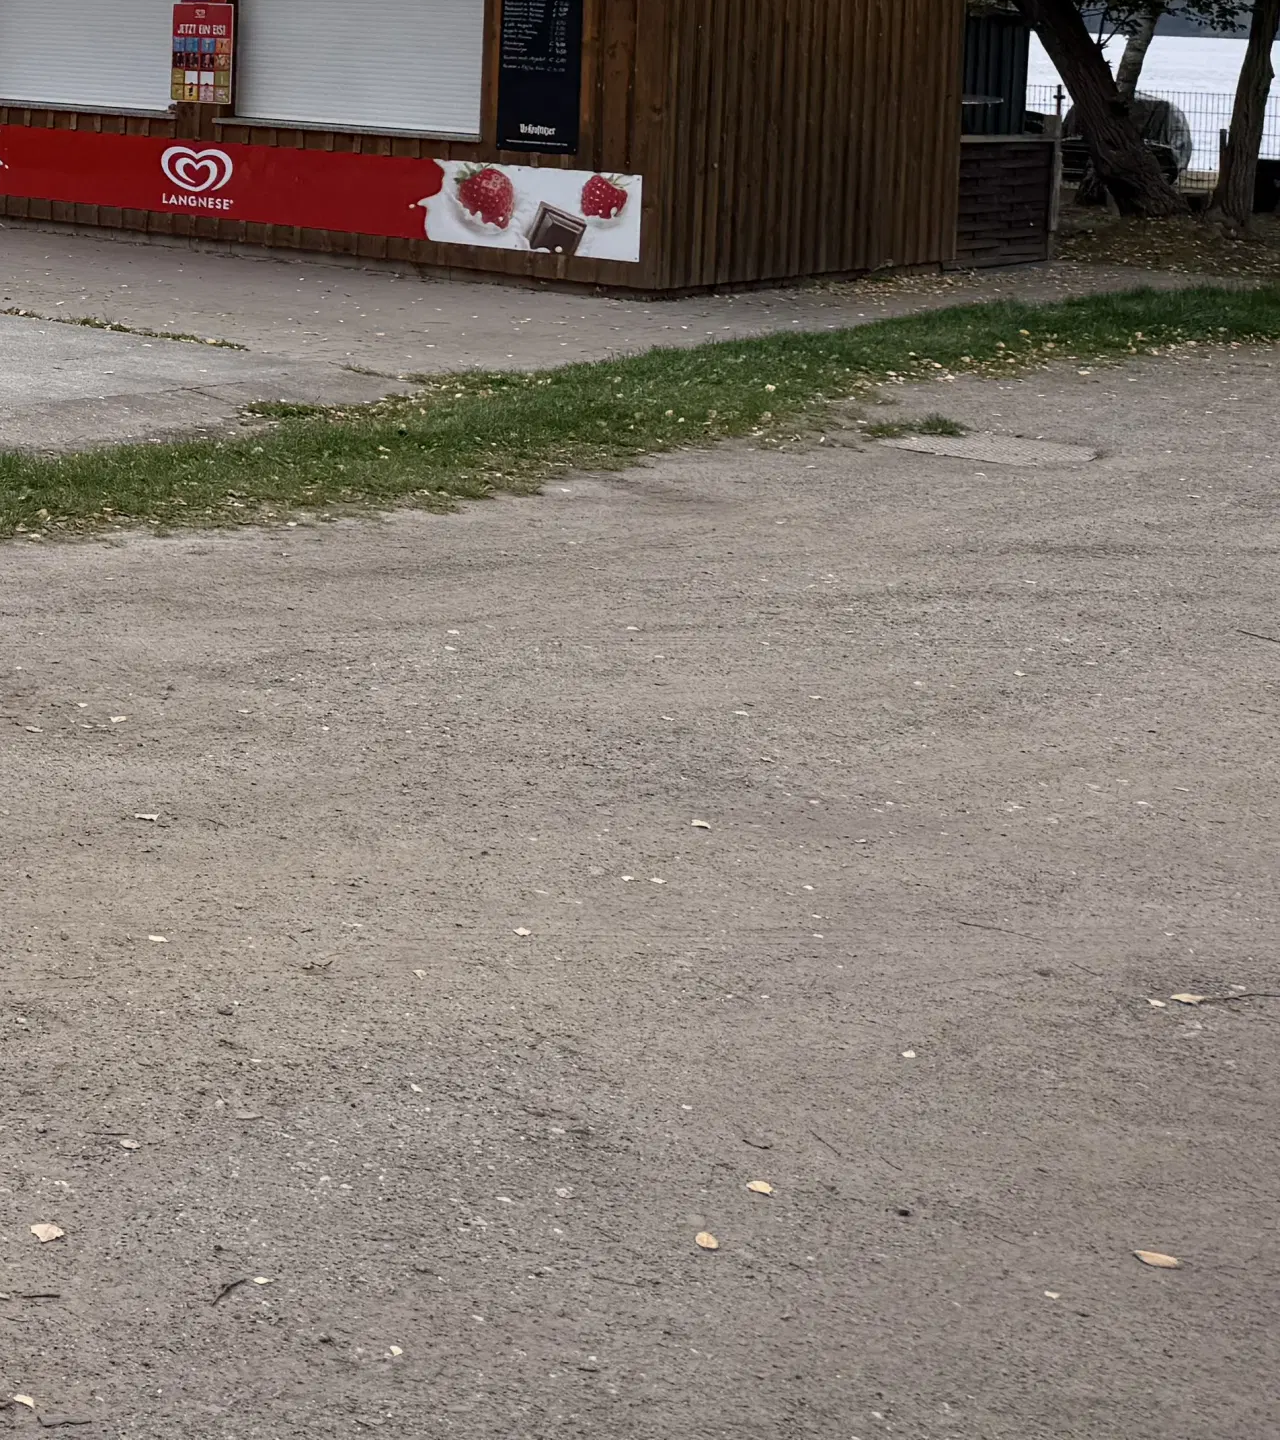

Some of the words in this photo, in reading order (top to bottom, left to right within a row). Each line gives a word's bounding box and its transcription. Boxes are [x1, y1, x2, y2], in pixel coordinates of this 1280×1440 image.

[177, 23, 197, 35] JETZT
[198, 24, 211, 35] EIN
[162, 192, 230, 210] LANGNESE
